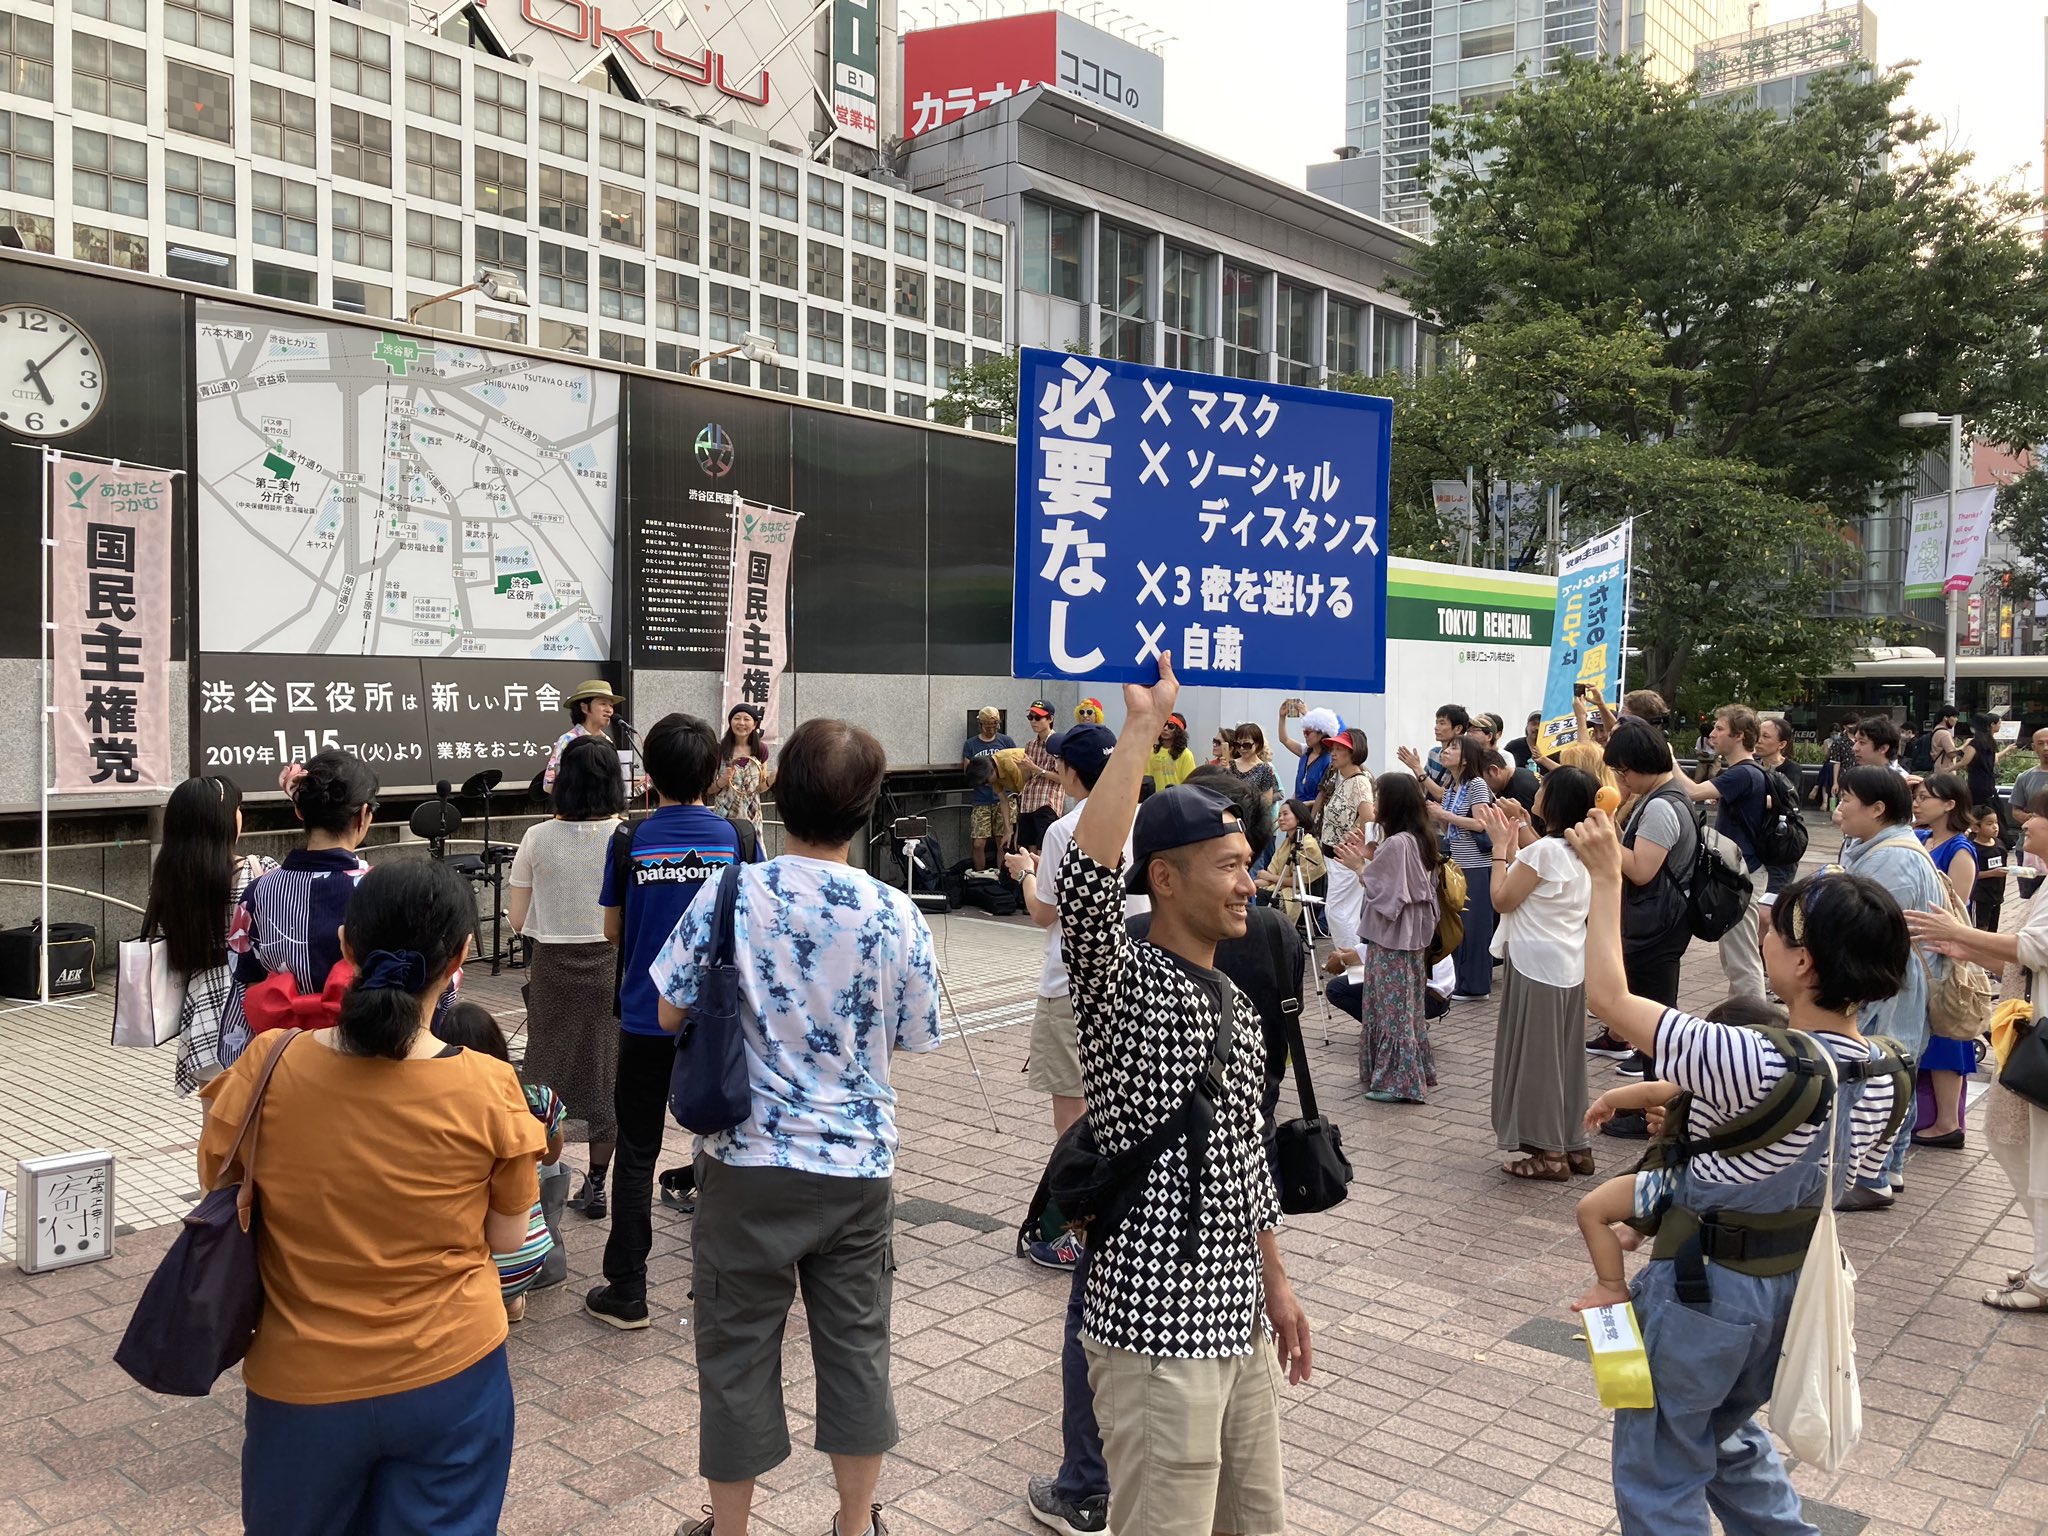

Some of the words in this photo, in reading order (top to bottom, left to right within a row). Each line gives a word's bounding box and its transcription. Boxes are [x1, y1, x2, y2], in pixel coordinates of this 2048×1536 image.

[480, 0, 770, 105] OKYU
[847, 70, 865, 89] B1
[1060, 49, 1139, 109] ココロの
[835, 103, 876, 134] 営業中
[18, 311, 49, 332] 12
[201, 326, 253, 341] 六本木通り
[269, 334, 316, 349] 渋谷ヒカリエ
[383, 343, 414, 358] 渋谷駅
[417, 366, 446, 377] ハチ公像
[80, 370, 98, 389] 3
[256, 373, 287, 387] 宮益坂
[484, 379, 529, 392] SHIBUYA109
[524, 373, 556, 385] TSUTAYA
[12, 389, 55, 402] CITIZ
[199, 380, 239, 397] 青山通り
[1188, 388, 1280, 438] マスク
[25, 412, 44, 431] 6
[391, 421, 406, 430] 渋谷
[501, 416, 538, 441] 文化村通り
[391, 432, 411, 440] マルイ
[455, 432, 493, 456] 井ノ頭通り
[287, 449, 323, 473] 美竹通り
[406, 465, 421, 474] 渋谷
[576, 469, 608, 480] 東急百貨店
[1186, 449, 1341, 503] ソーシャル
[255, 477, 300, 492] 第二美竹
[401, 475, 421, 483] モディ
[595, 480, 608, 489] 本店
[100, 480, 164, 497] あなたと
[473, 481, 507, 492] 東急ハンズ
[261, 491, 295, 505] 分庁舎
[333, 496, 357, 504] cocoti
[389, 494, 437, 505] タワーレコード
[486, 493, 507, 502] 渋谷店
[111, 497, 159, 513] つかむ
[388, 503, 411, 512] 渋谷店
[374, 510, 385, 519] JR
[1038, 356, 1116, 674] 必要なし
[465, 521, 480, 529] 渋谷
[760, 521, 791, 533] あなたと
[1198, 497, 1380, 556] ディスタンス
[319, 531, 335, 540] 渋谷
[465, 530, 499, 540] 東武ホテル
[763, 533, 786, 544] つかむ
[306, 540, 335, 549] キャスト
[399, 542, 444, 553] 勤労福祉会館
[494, 555, 529, 565] 神南小学校
[385, 581, 400, 589] 渋谷
[511, 578, 529, 589] 渋谷
[338, 575, 355, 613] 明治通り
[385, 590, 408, 599] 消防署
[507, 590, 534, 601] 区役所
[363, 591, 374, 620] 至原宿
[533, 603, 547, 611] 渋谷
[526, 611, 546, 620] 税務署
[1437, 607, 1477, 637] TOKYU
[1483, 611, 1532, 640] RENEWAL
[80, 521, 145, 785] 国民主権党
[543, 643, 580, 652] 放送センター
[1183, 622, 1244, 671] 自粛
[431, 681, 571, 713] 新しい庁舎
[1794, 730, 1816, 739] KEIO
[436, 739, 556, 760] 業務をおこなっ
[636, 865, 721, 885] patagoni
[55, 967, 84, 982] AER
[44, 1174, 93, 1245] 寄付
